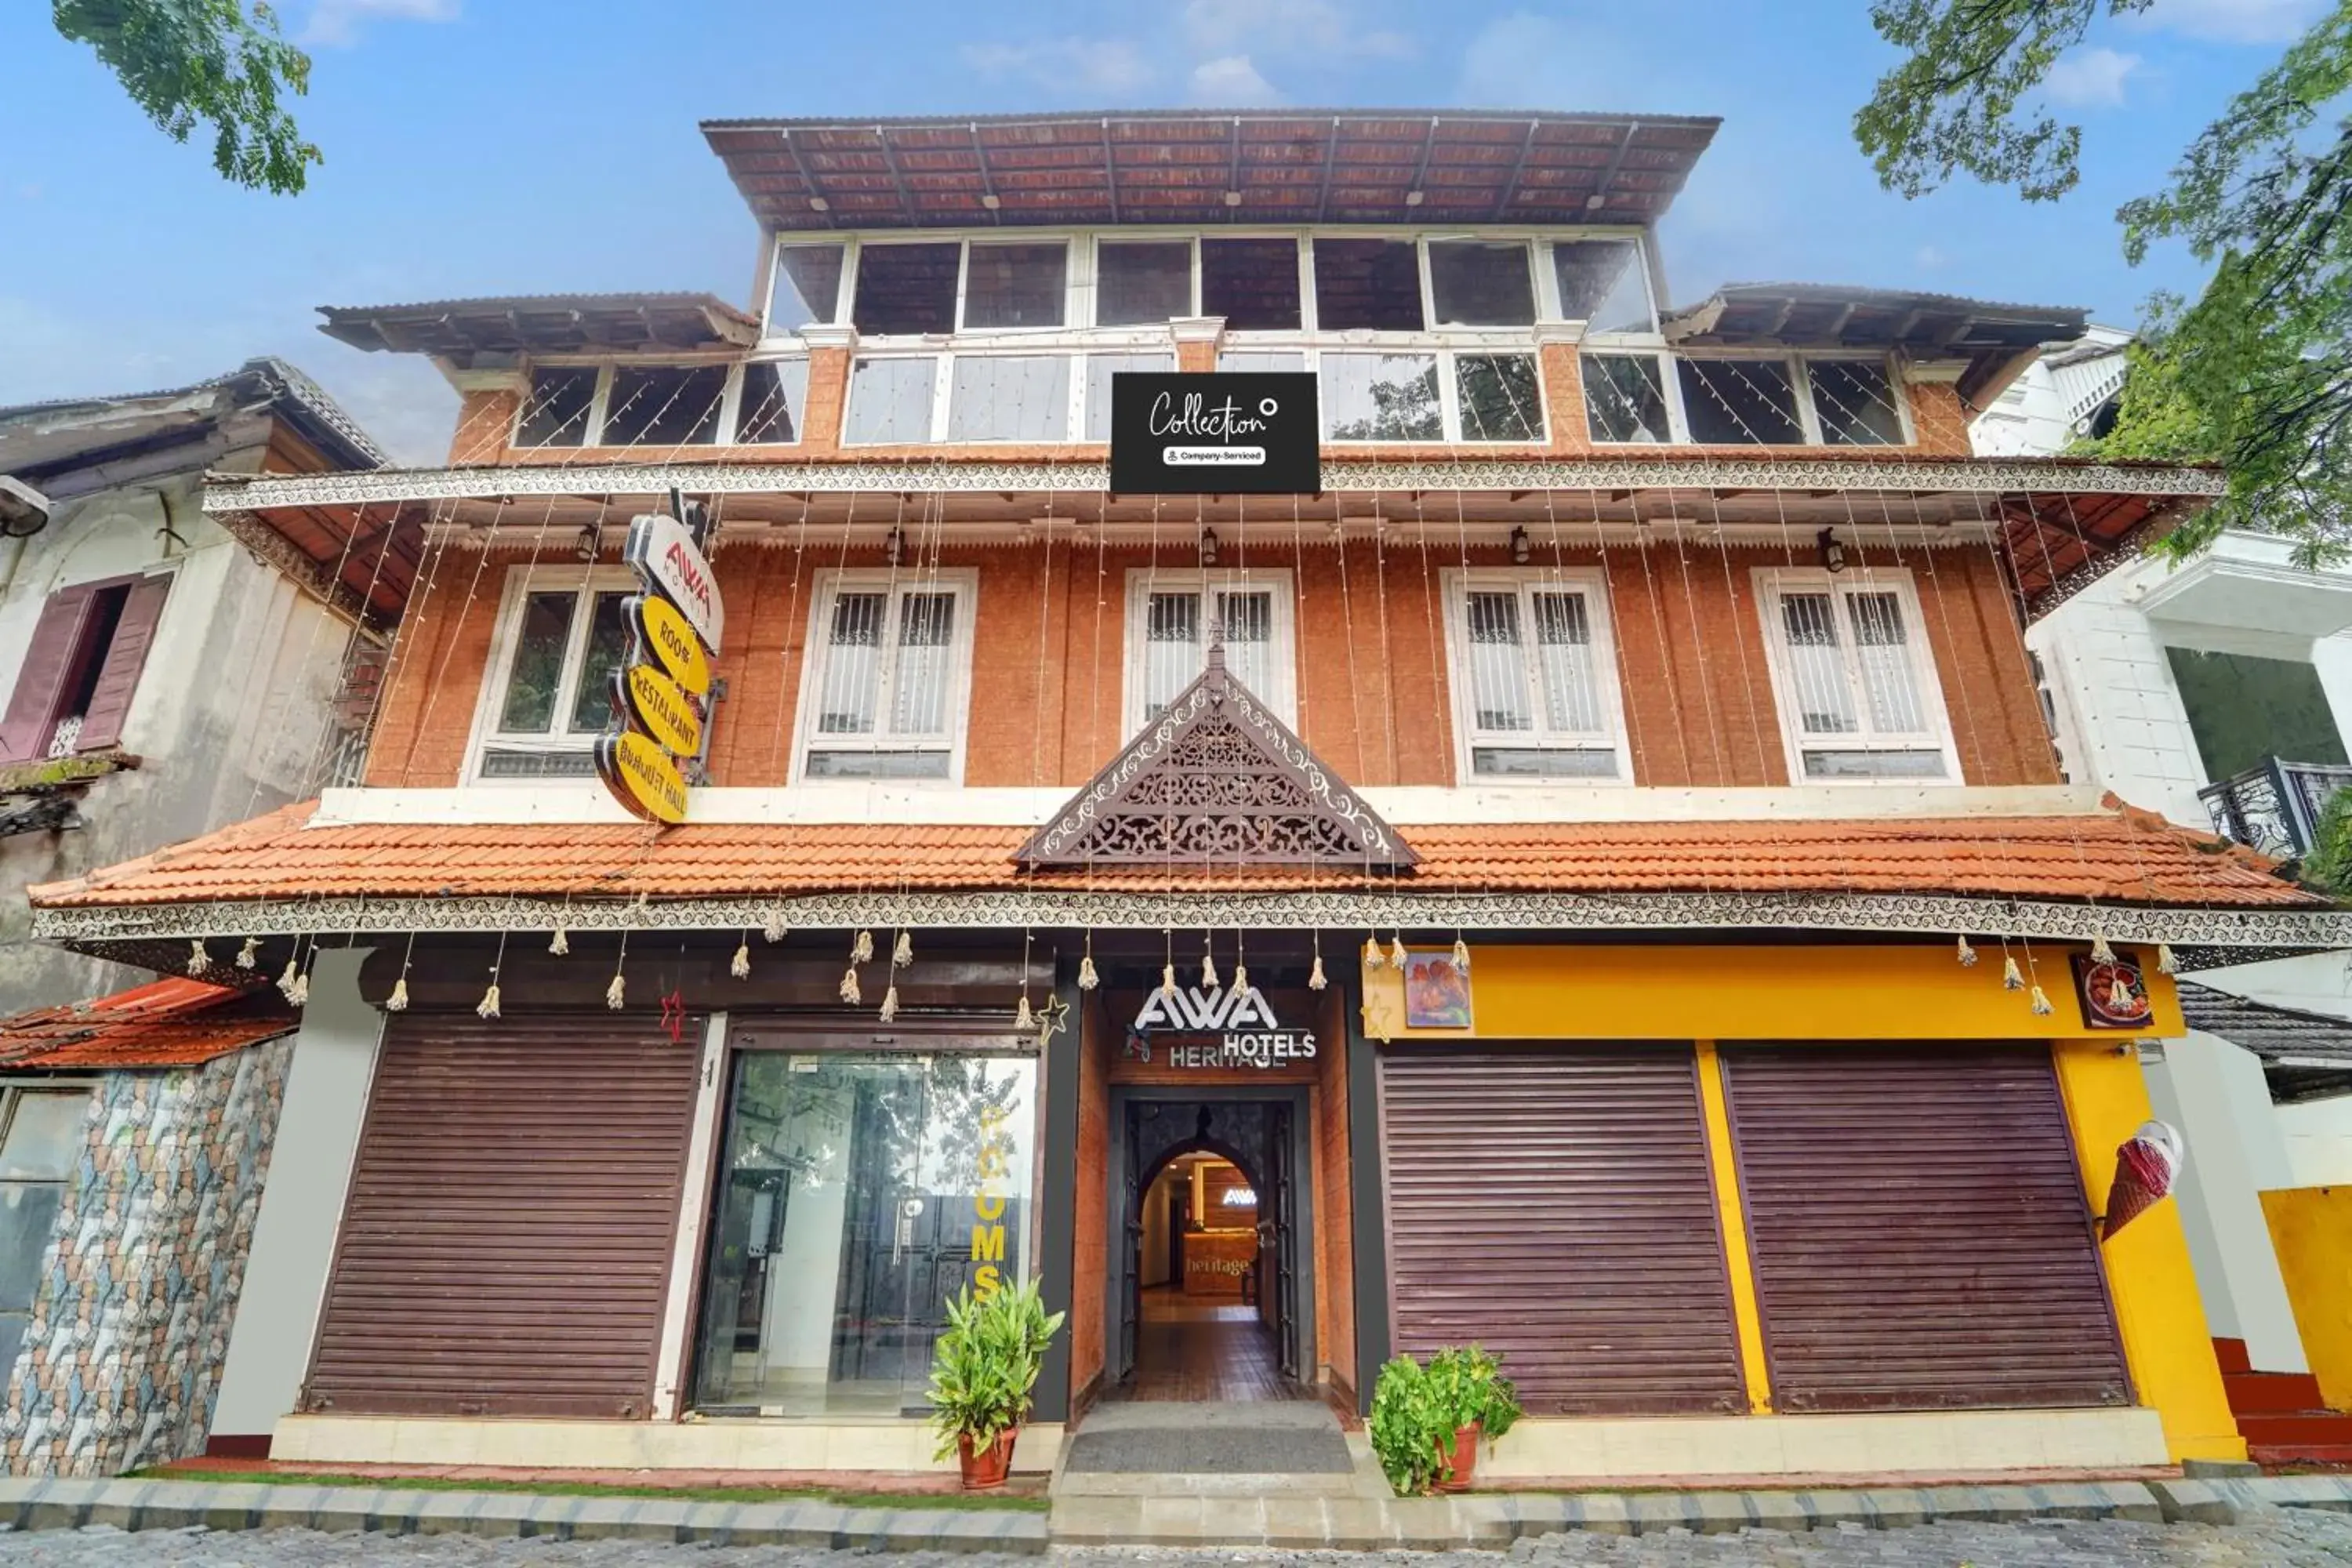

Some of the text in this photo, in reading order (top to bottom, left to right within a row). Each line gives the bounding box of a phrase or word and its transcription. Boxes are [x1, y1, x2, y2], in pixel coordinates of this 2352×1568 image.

[1149, 391, 1266, 444] Collection
[1180, 452, 1261, 461] Company-Serviced
[1134, 985, 1278, 1029] AWA
[1224, 1033, 1316, 1058] HOTELS
[1223, 1189, 1258, 1205] AW
